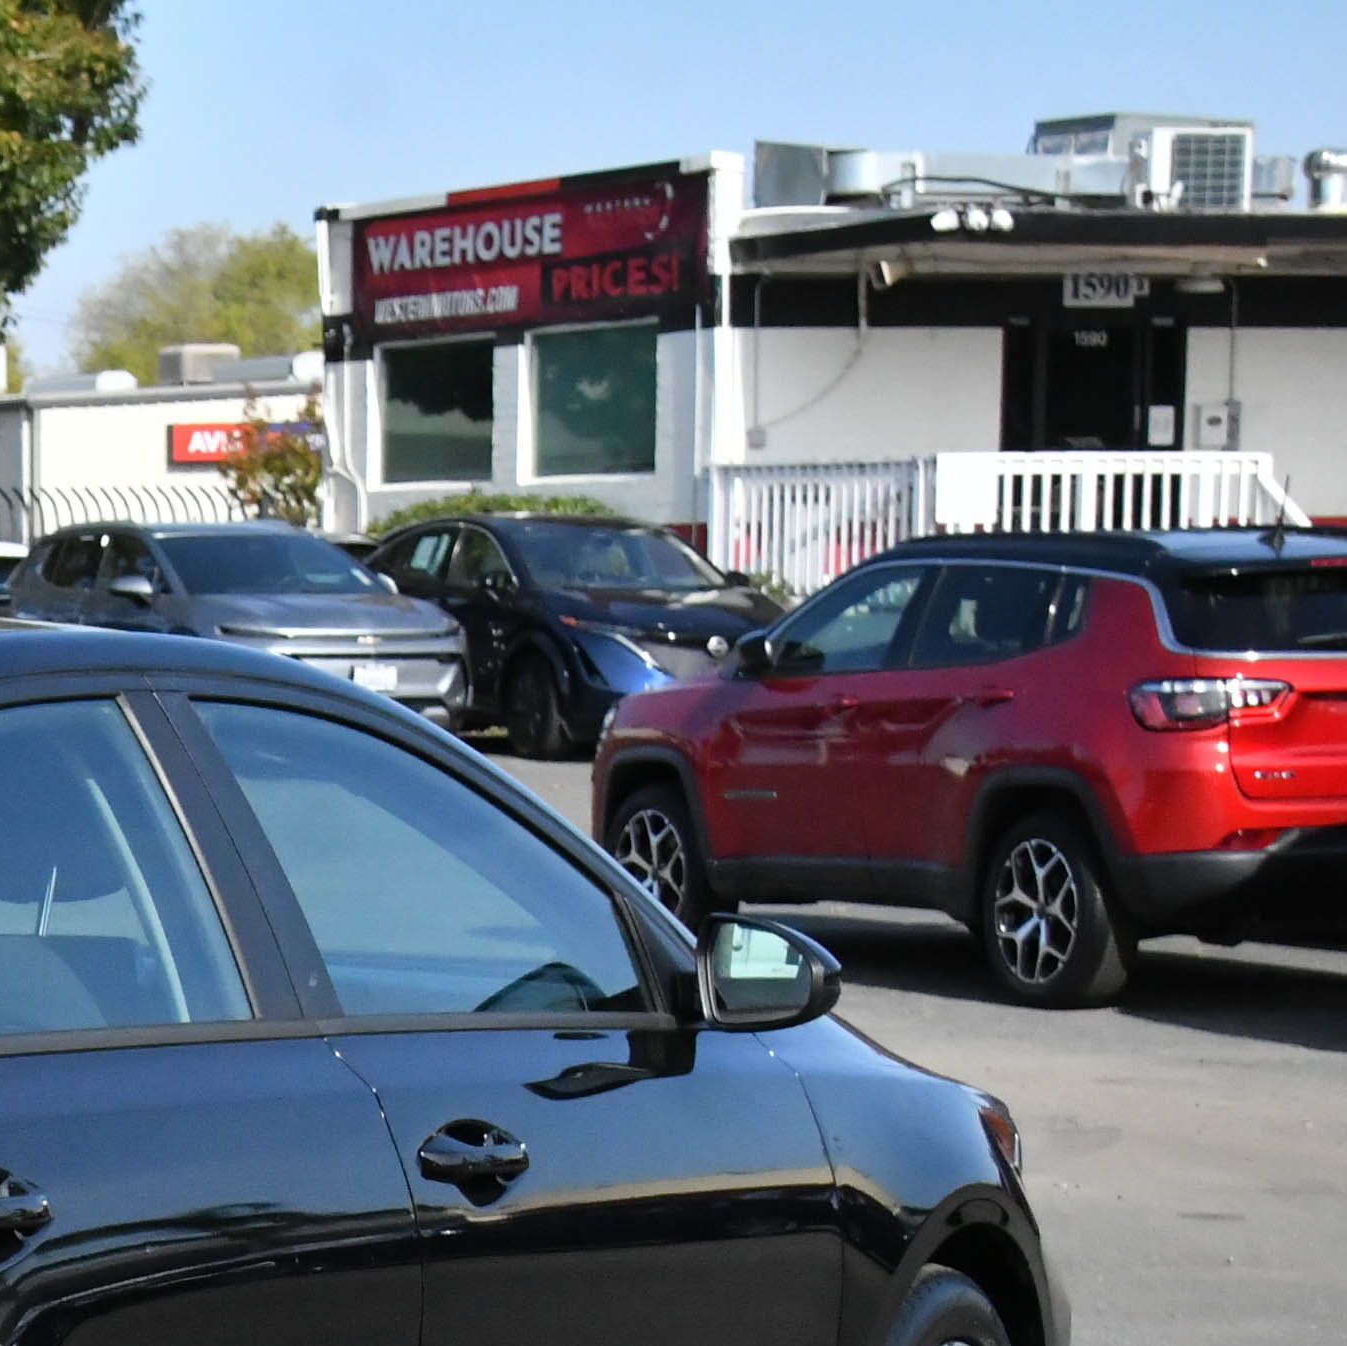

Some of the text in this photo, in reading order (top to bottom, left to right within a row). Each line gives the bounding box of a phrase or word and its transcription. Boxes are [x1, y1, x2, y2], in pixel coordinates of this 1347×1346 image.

[367, 212, 563, 275] WAREHOUSE
[1071, 272, 1130, 300] 1590
[1073, 329, 1108, 347] 1590
